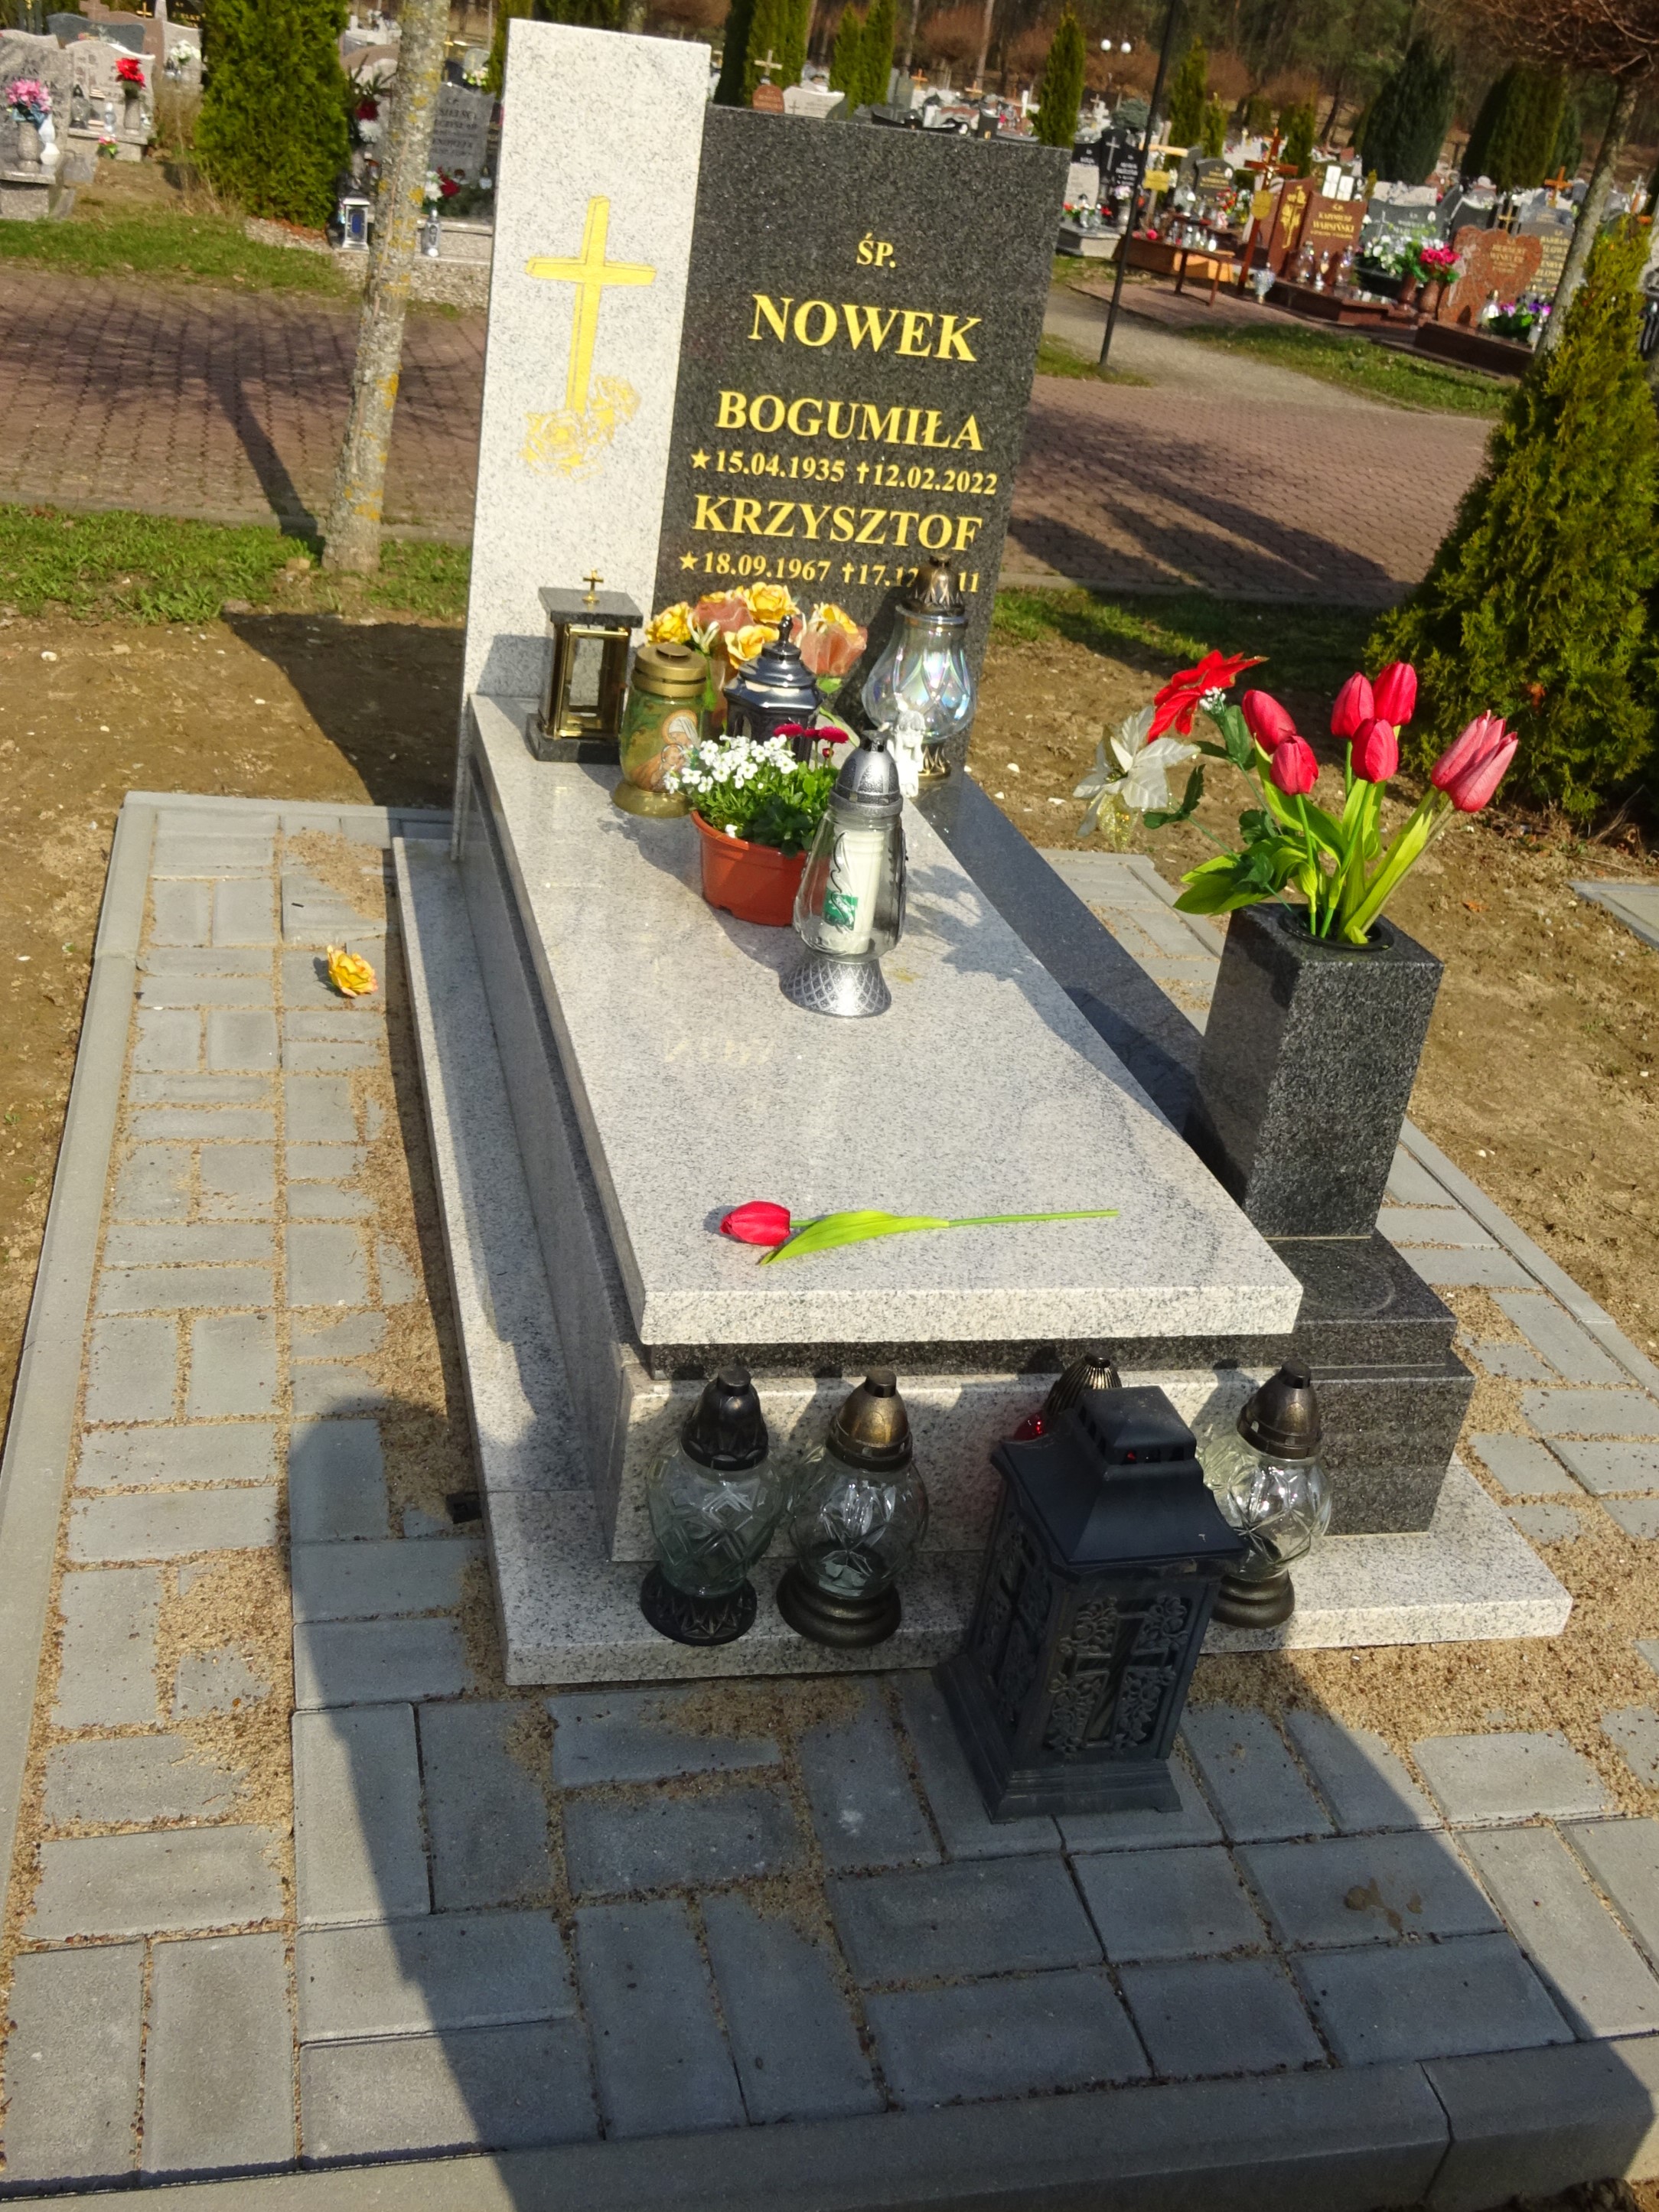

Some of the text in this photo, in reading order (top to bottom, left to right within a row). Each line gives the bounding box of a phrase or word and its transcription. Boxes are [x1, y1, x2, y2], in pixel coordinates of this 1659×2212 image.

[857, 233, 896, 268] ŚP.
[749, 294, 982, 362] NOWEK
[715, 391, 984, 451] BOGUMIŁA
[716, 449, 998, 495] 15.04.1935 12.02.2022
[693, 494, 983, 552] KRZYSZTOF
[703, 551, 832, 582] 18.09.1967
